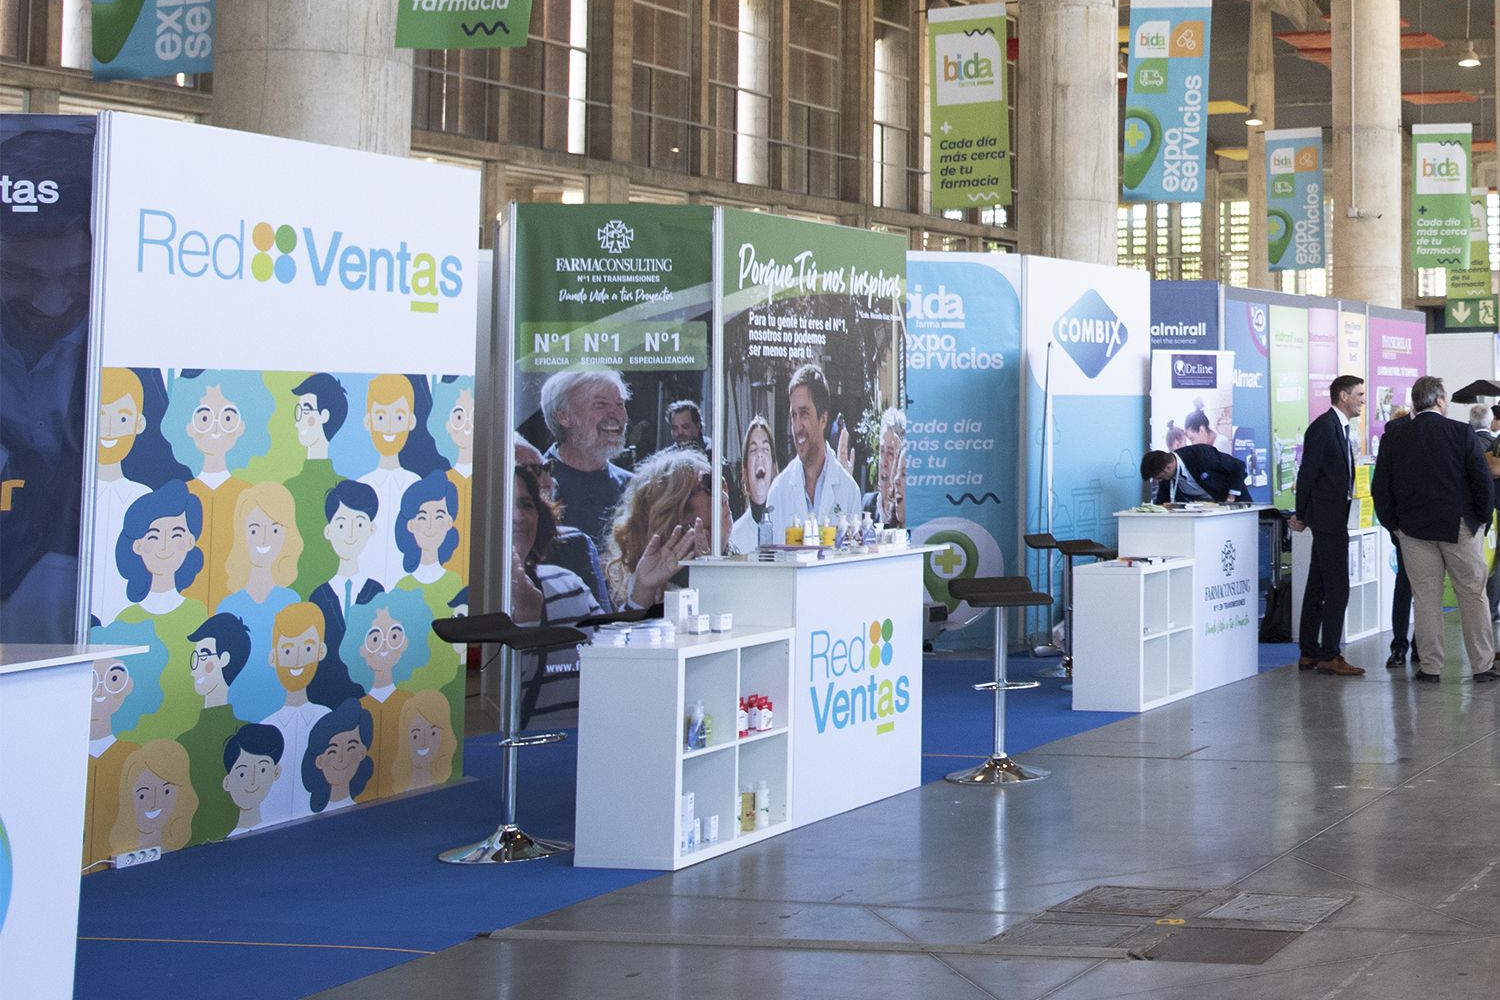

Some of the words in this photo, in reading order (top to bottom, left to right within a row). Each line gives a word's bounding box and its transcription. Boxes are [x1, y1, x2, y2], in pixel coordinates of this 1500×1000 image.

[1140, 32, 1165, 47] bida
[943, 52, 994, 81] bida
[1178, 74, 1202, 193] servicios
[940, 138, 973, 151] Cada
[976, 135, 997, 148] día
[940, 151, 967, 163] más
[970, 149, 1006, 161] cerca
[1162, 127, 1182, 193] expo
[940, 165, 956, 177] de
[960, 164, 973, 175] tu
[1423, 157, 1460, 177] bida
[940, 175, 999, 190] farmacia
[1303, 183, 1320, 264] servicios
[1416, 218, 1443, 227] Cada
[1444, 217, 1461, 227] día
[1416, 227, 1438, 236] más
[1439, 228, 1468, 236] cerca
[1295, 220, 1308, 265] expo
[1416, 237, 1430, 246] de
[1431, 237, 1442, 246] tu
[137, 208, 246, 281] Red
[302, 226, 464, 299] Ventas
[1416, 246, 1461, 255] farmacia
[556, 258, 673, 272] FARMACONSULTING
[591, 275, 602, 283] EN
[602, 275, 660, 283] TRANSMISIONES
[738, 243, 795, 305] Porque
[793, 250, 818, 294] Tú
[822, 266, 846, 293] nos
[558, 287, 587, 304] Dando
[749, 311, 767, 326] Para
[767, 313, 776, 327] tu
[777, 316, 798, 330] gente
[799, 315, 808, 329] tú
[808, 318, 824, 330] eres
[824, 317, 832, 331] el
[915, 319, 941, 328] farma
[1151, 322, 1206, 336] almirall
[748, 329, 782, 342] nosotros
[783, 332, 793, 342] no
[793, 330, 827, 346] podemos
[1058, 317, 1122, 357] COMBIX
[1174, 337, 1197, 345] science
[748, 344, 761, 357] ser
[762, 345, 787, 358] menos
[788, 347, 805, 360] para
[805, 345, 814, 359] ti.
[534, 357, 570, 366] EFICACIA
[580, 357, 623, 365] SEGURIDAD
[629, 355, 695, 365] ESPECIALIZACIÓN
[1185, 363, 1213, 375] Dr.line
[953, 418, 983, 433] día
[943, 438, 994, 450] cerca
[927, 456, 947, 468] tu
[905, 471, 984, 486] armacia
[810, 622, 866, 682] Red
[810, 674, 910, 735] Ventas
